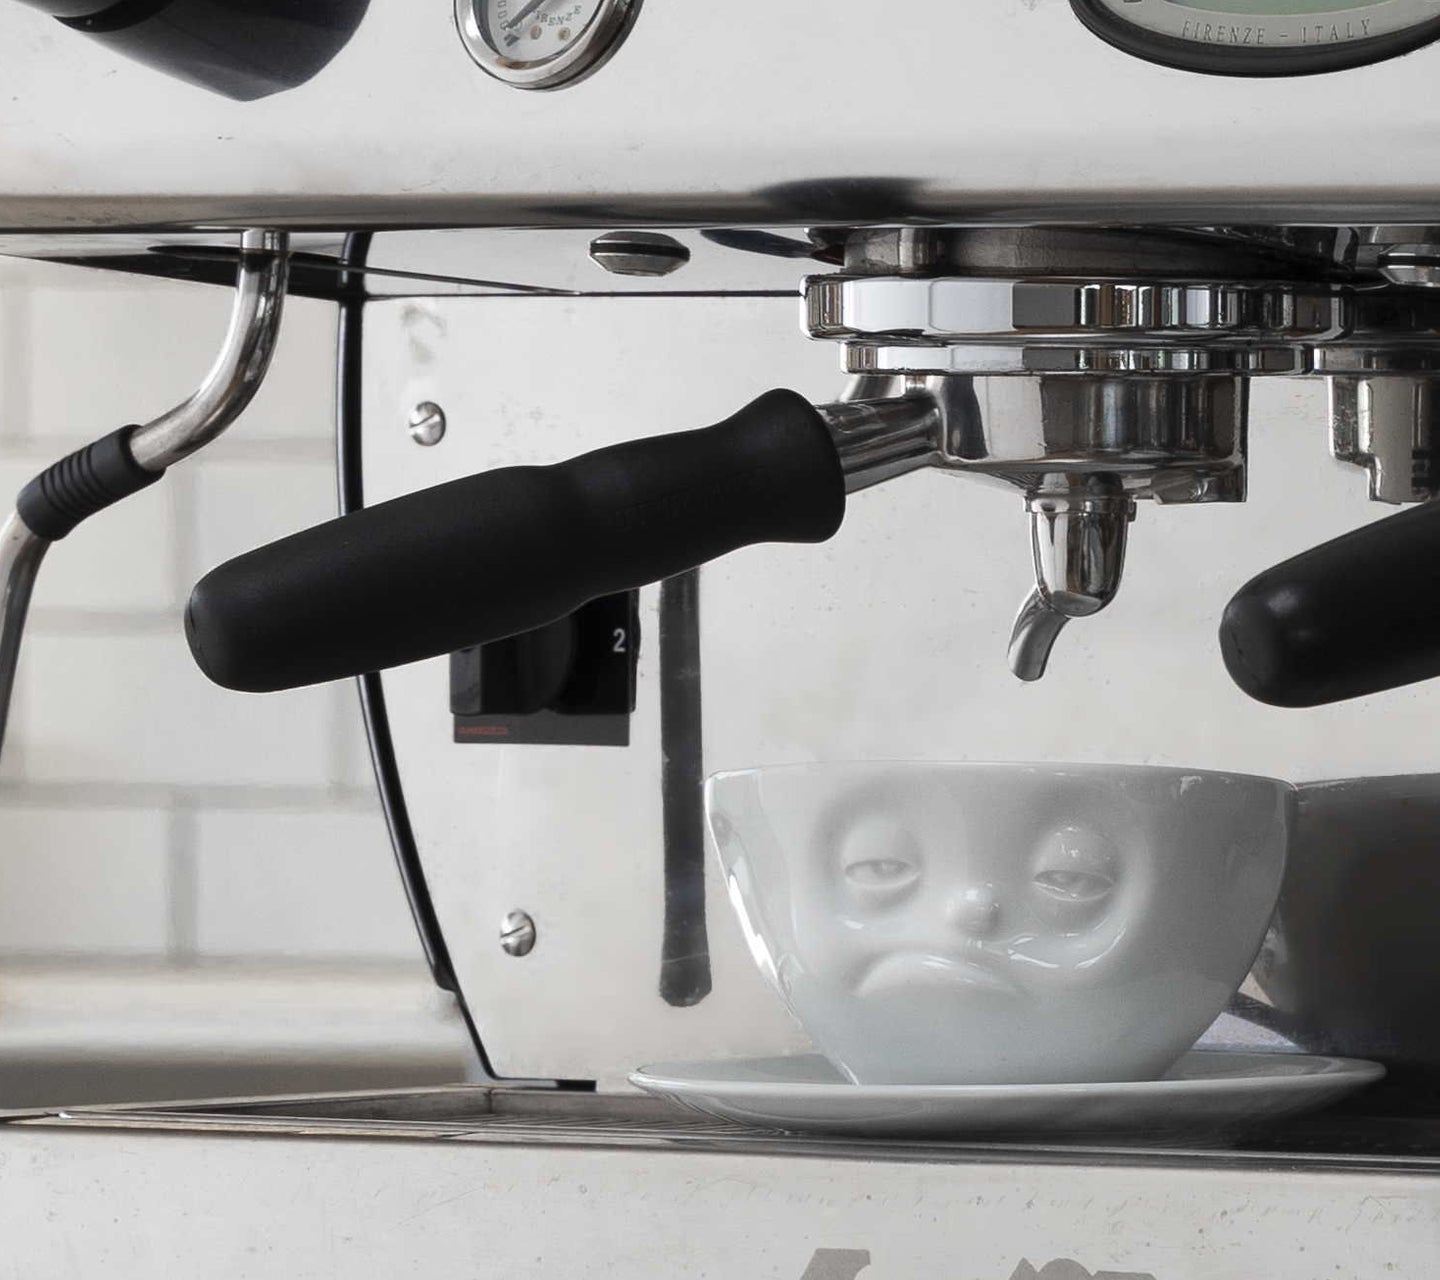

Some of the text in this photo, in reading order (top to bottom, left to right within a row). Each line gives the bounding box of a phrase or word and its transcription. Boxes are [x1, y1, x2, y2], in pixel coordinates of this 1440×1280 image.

[535, 5, 582, 27] IRENZE
[1182, 20, 1266, 45] FIRENZE
[1301, 19, 1371, 44] ITALY
[612, 628, 626, 653] 2
